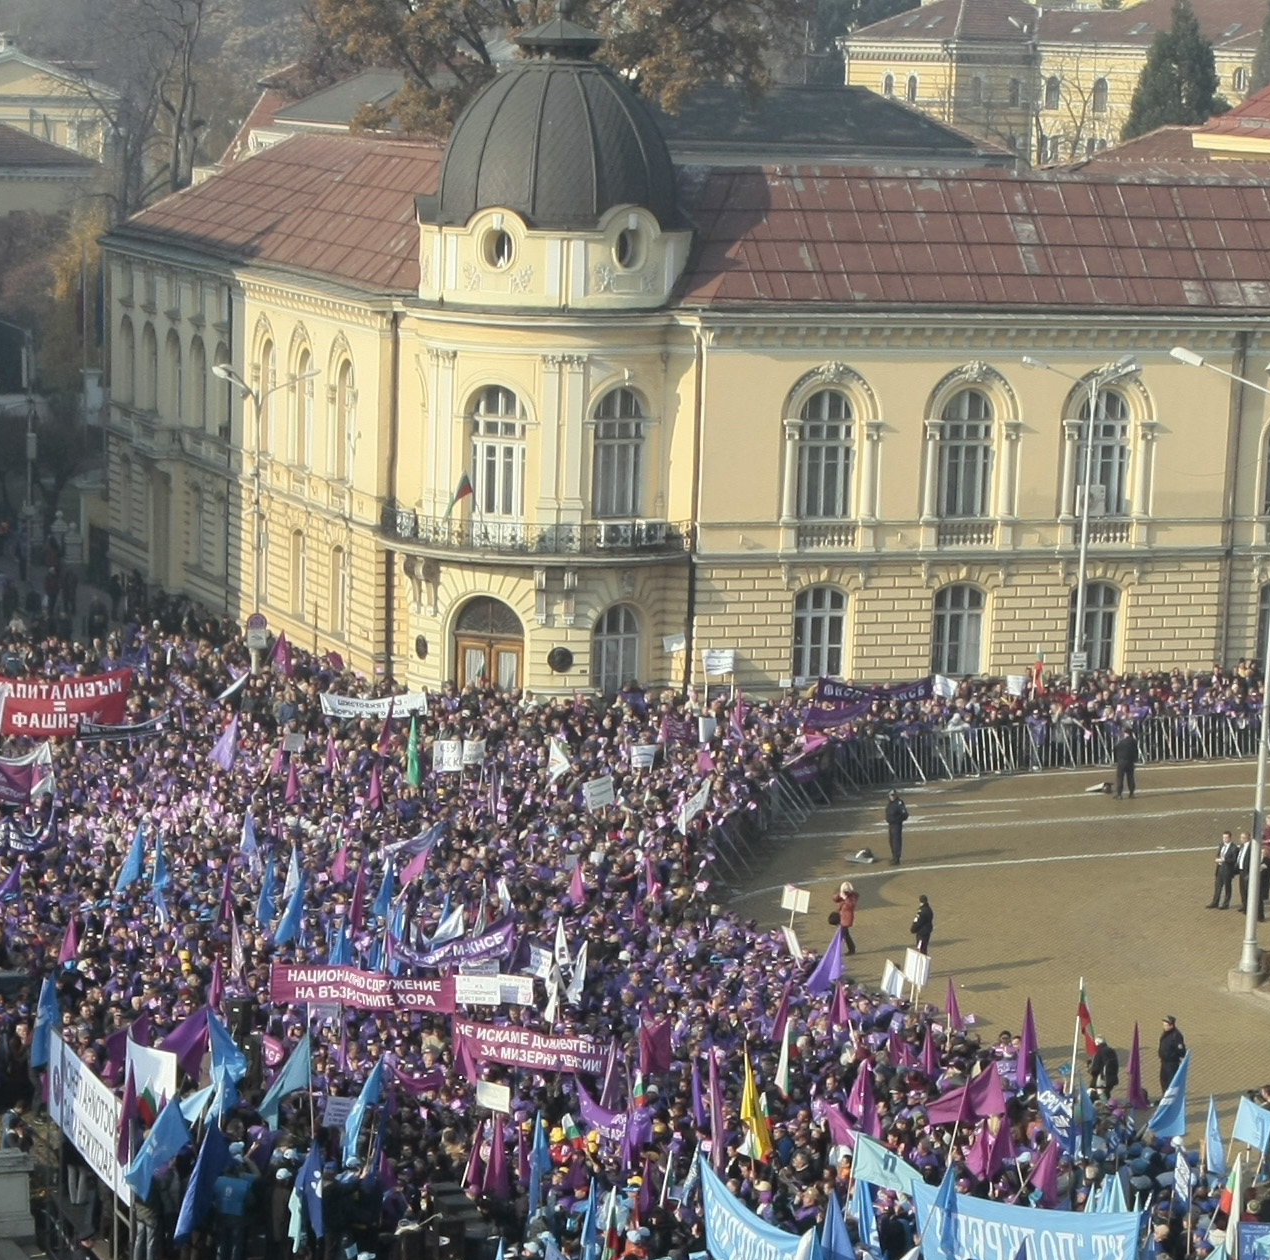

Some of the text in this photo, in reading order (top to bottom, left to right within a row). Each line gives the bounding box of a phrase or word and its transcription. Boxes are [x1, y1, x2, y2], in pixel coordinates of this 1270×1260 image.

[366, 978, 442, 992] СДРУЖЕНИЕ
[295, 987, 315, 999] НА
[397, 993, 436, 1006] ХОРА
[455, 1022, 475, 1037] НЕ
[476, 1027, 530, 1046] ИСКАМЕ
[481, 1044, 499, 1058] ЗА
